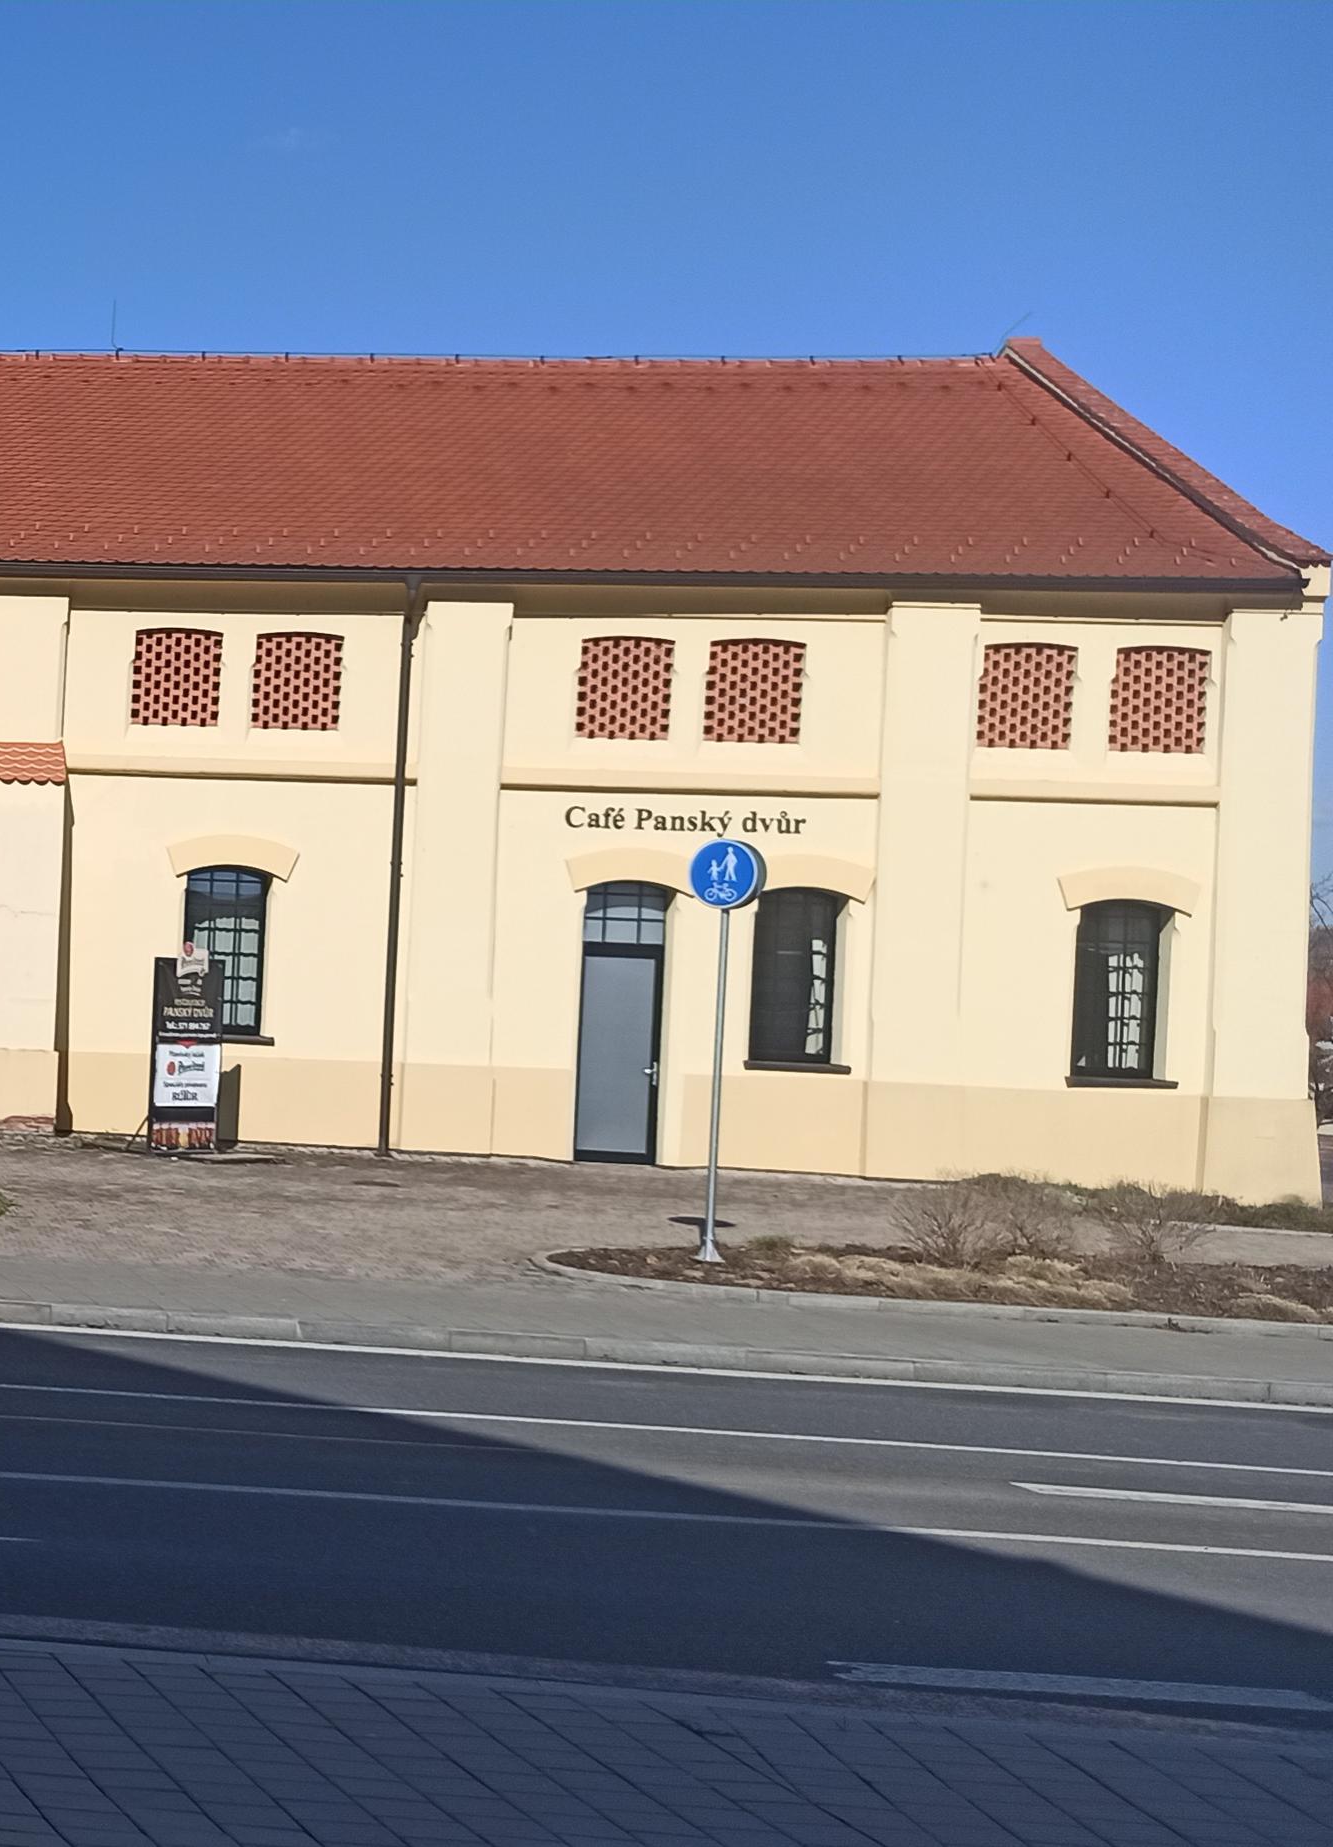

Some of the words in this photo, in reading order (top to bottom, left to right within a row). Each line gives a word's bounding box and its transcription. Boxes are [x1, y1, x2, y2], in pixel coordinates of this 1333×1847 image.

[565, 806, 625, 829] Café
[634, 808, 732, 837] Panský
[742, 811, 807, 834] dvůr
[164, 1006, 192, 1017] PANSKÝ
[193, 1006, 213, 1018] DVŮR
